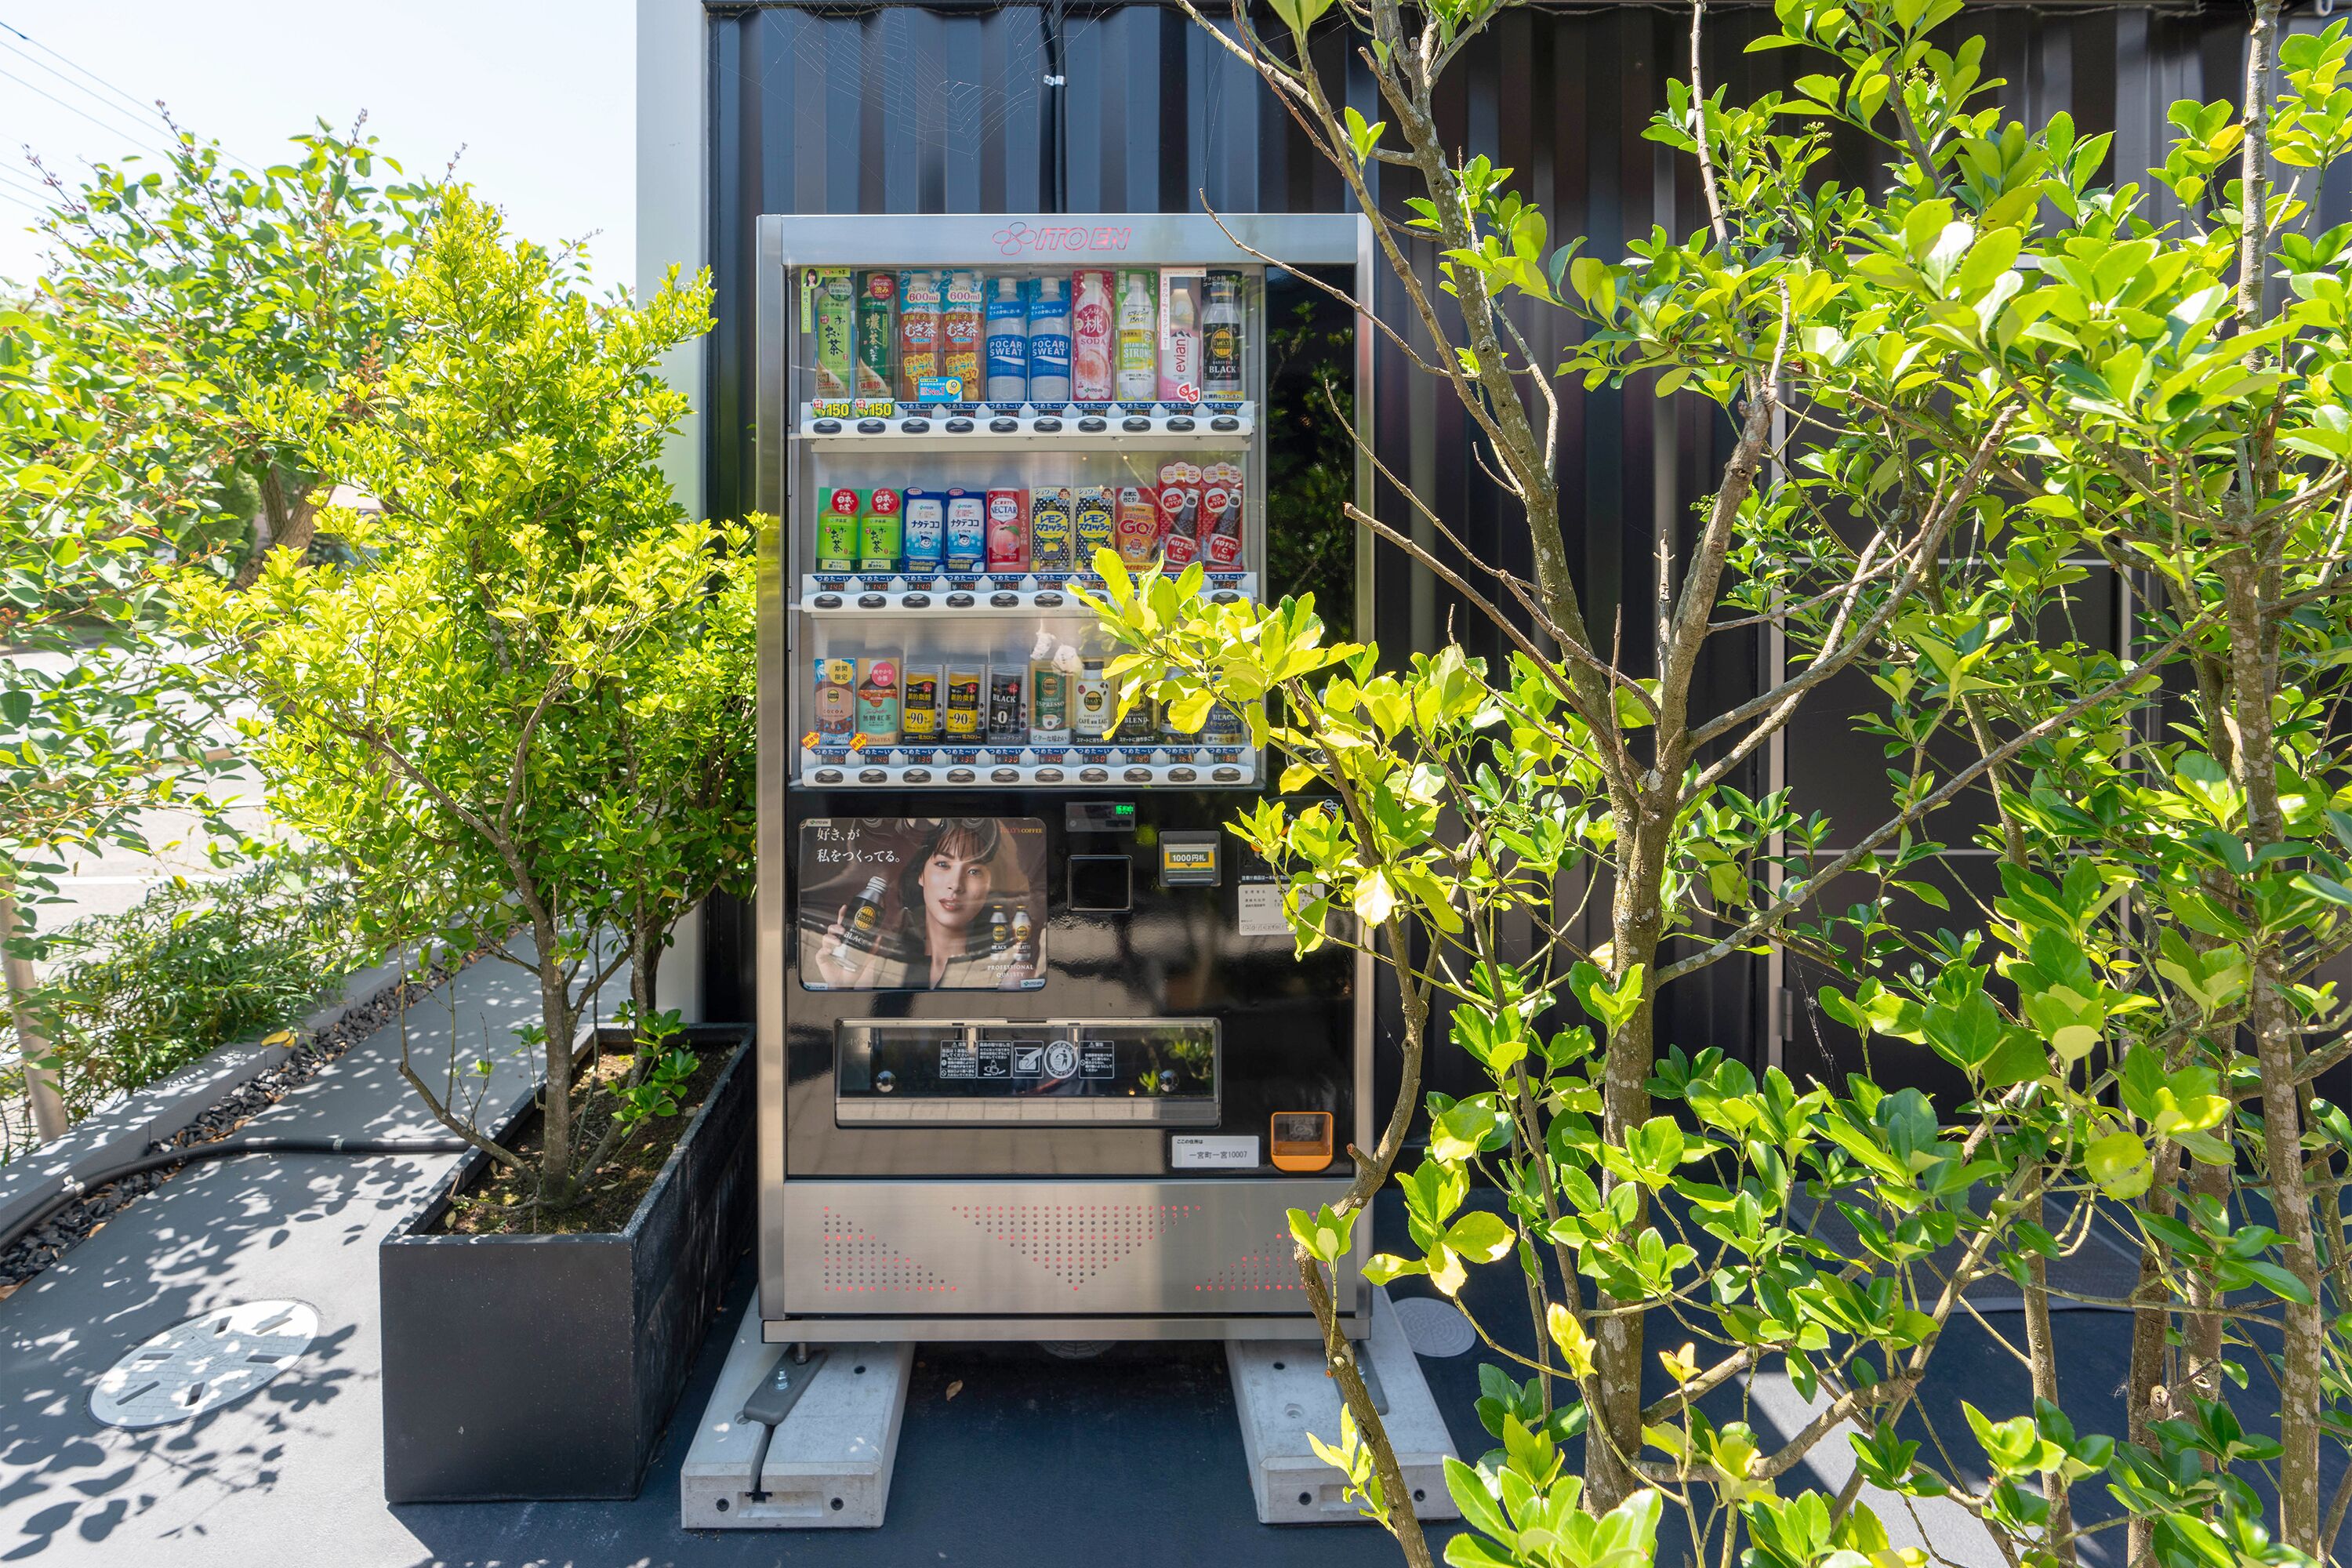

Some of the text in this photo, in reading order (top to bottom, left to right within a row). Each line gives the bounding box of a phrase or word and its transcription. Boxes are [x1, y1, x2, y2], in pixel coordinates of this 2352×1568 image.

[909, 292, 938, 302] 600ml
[950, 292, 980, 301] 600ml
[905, 321, 937, 337] むぎ茶
[946, 321, 978, 337] むぎ茶
[1084, 316, 1103, 333] 桃
[989, 340, 1025, 350] POCARI
[1032, 340, 1069, 350] POCARI
[989, 348, 1023, 357] SWEAT
[1032, 348, 1065, 357] SWEAT
[1174, 339, 1186, 372] evian
[821, 404, 850, 416] ¥150
[863, 404, 892, 416] ¥150
[950, 519, 979, 528] ナタデココ
[1040, 514, 1063, 523] レモン
[1083, 514, 1106, 523] レモン
[911, 520, 940, 529] ナタデココ
[1035, 523, 1067, 532] スカッシュ
[1078, 523, 1110, 532] スカッシュ
[1120, 519, 1155, 536] GO!
[993, 693, 1016, 703] BLACK
[910, 711, 924, 724] 90
[953, 712, 968, 725] 90
[1033, 734, 1068, 742] ビターな味わい
[816, 827, 861, 841] 好き、が
[816, 848, 901, 862] 私をつくってる。
[1172, 854, 1207, 862] 1000円札
[1189, 1151, 1248, 1160] 一宮町一宮10007
